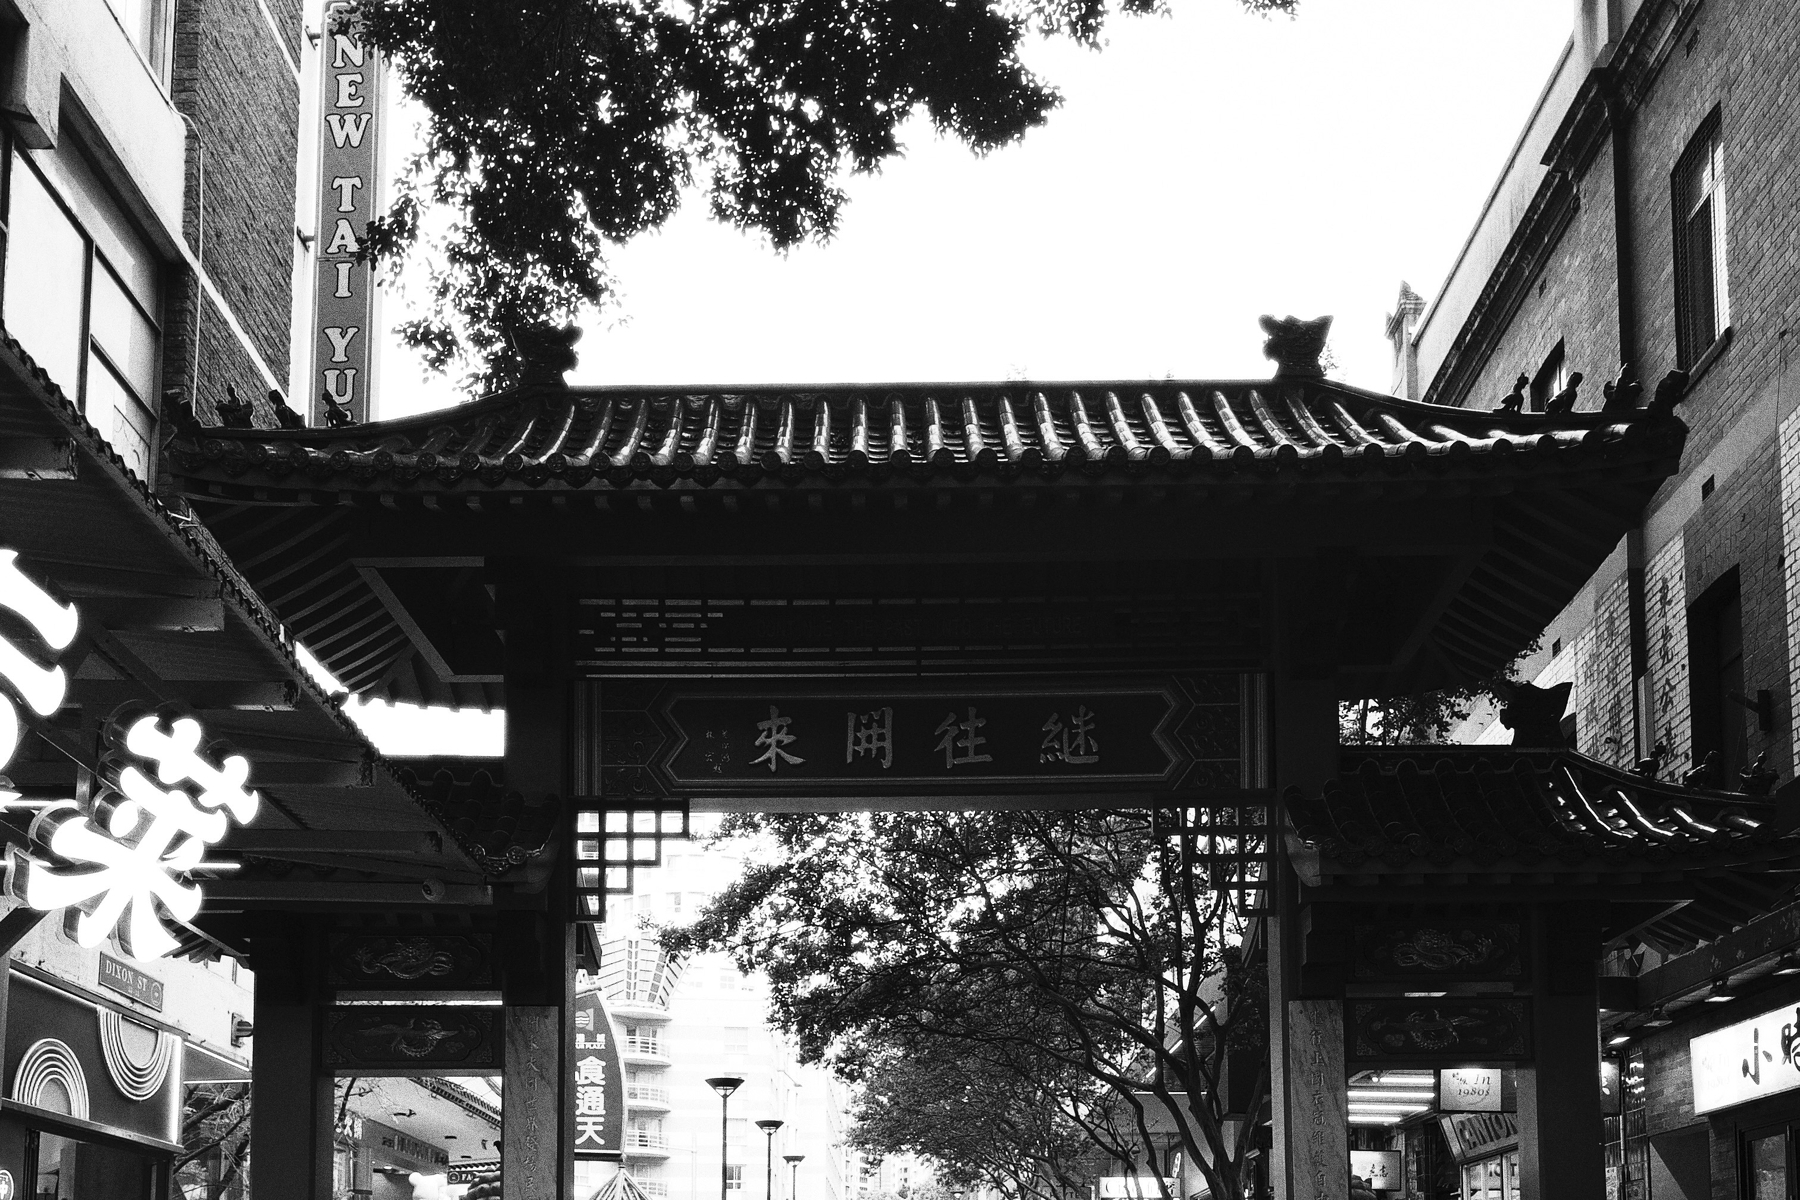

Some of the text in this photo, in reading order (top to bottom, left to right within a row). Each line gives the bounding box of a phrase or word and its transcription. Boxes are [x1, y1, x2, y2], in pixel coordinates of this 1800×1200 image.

[322, 32, 373, 427] NEW TAI YU
[106, 959, 148, 991] DIXON ST
[1458, 1088, 1491, 1098] 1980s
[1455, 1113, 1518, 1150] CANTON
